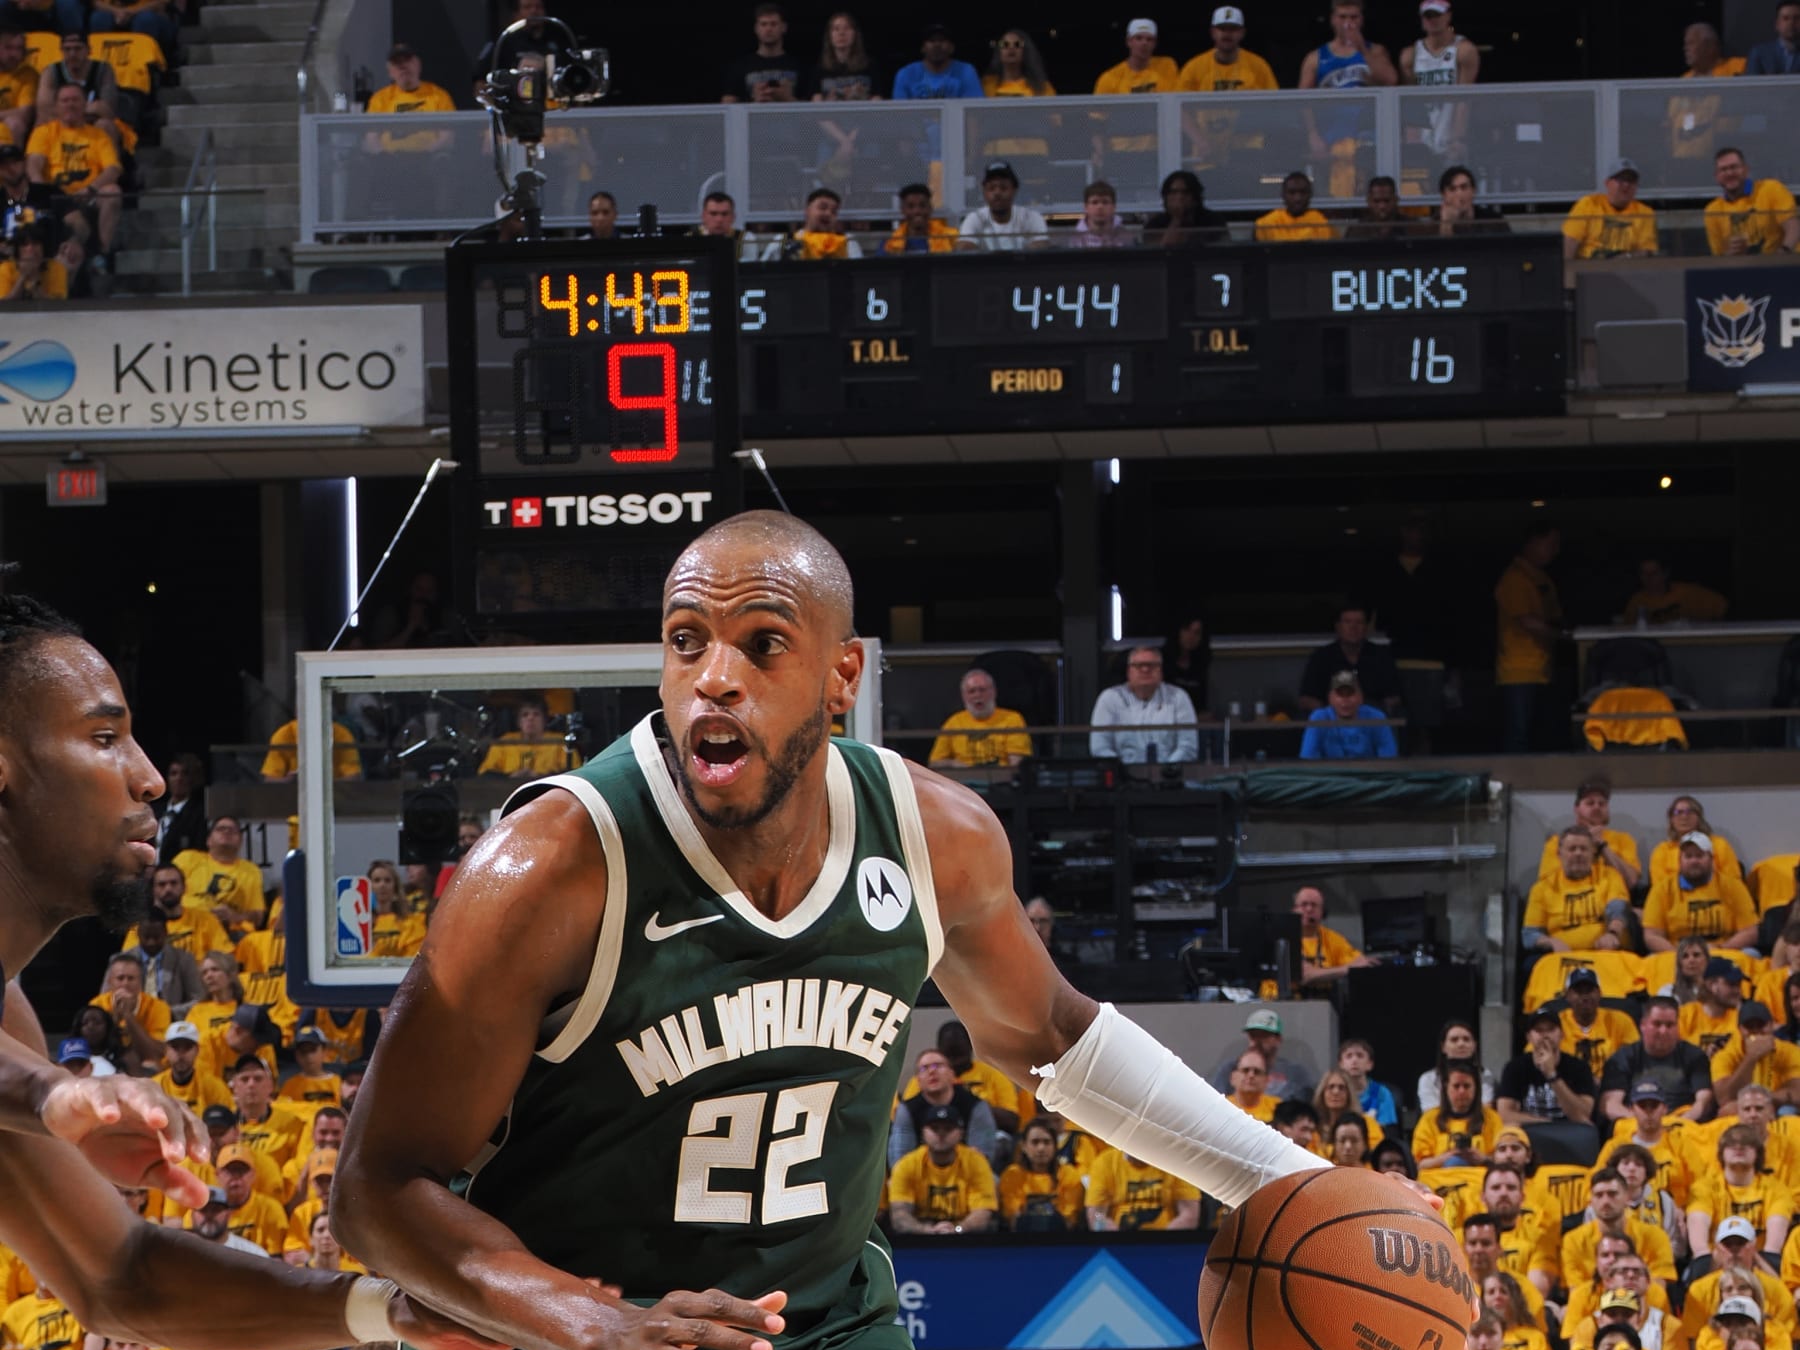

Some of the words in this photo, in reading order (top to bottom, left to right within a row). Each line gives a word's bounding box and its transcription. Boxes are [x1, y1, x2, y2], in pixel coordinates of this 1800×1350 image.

[540, 271, 689, 336] 4:43
[866, 287, 888, 321] 6
[1012, 283, 1120, 330] 4:44
[1210, 273, 1231, 307] 7
[1331, 266, 1468, 312] BUCKS
[113, 339, 396, 394] Kinetico
[850, 339, 910, 364] T.O.L.
[1410, 336, 1455, 384] 16
[991, 368, 1064, 393] PERIOD
[1111, 362, 1122, 394] 1
[22, 402, 132, 426] water
[151, 398, 307, 428] systems
[608, 342, 678, 463] 9
[57, 468, 97, 500] EXIT
[545, 491, 712, 527] TISSOT
[615, 978, 911, 1097] MILWAUKEE
[673, 1081, 840, 1225] 22
